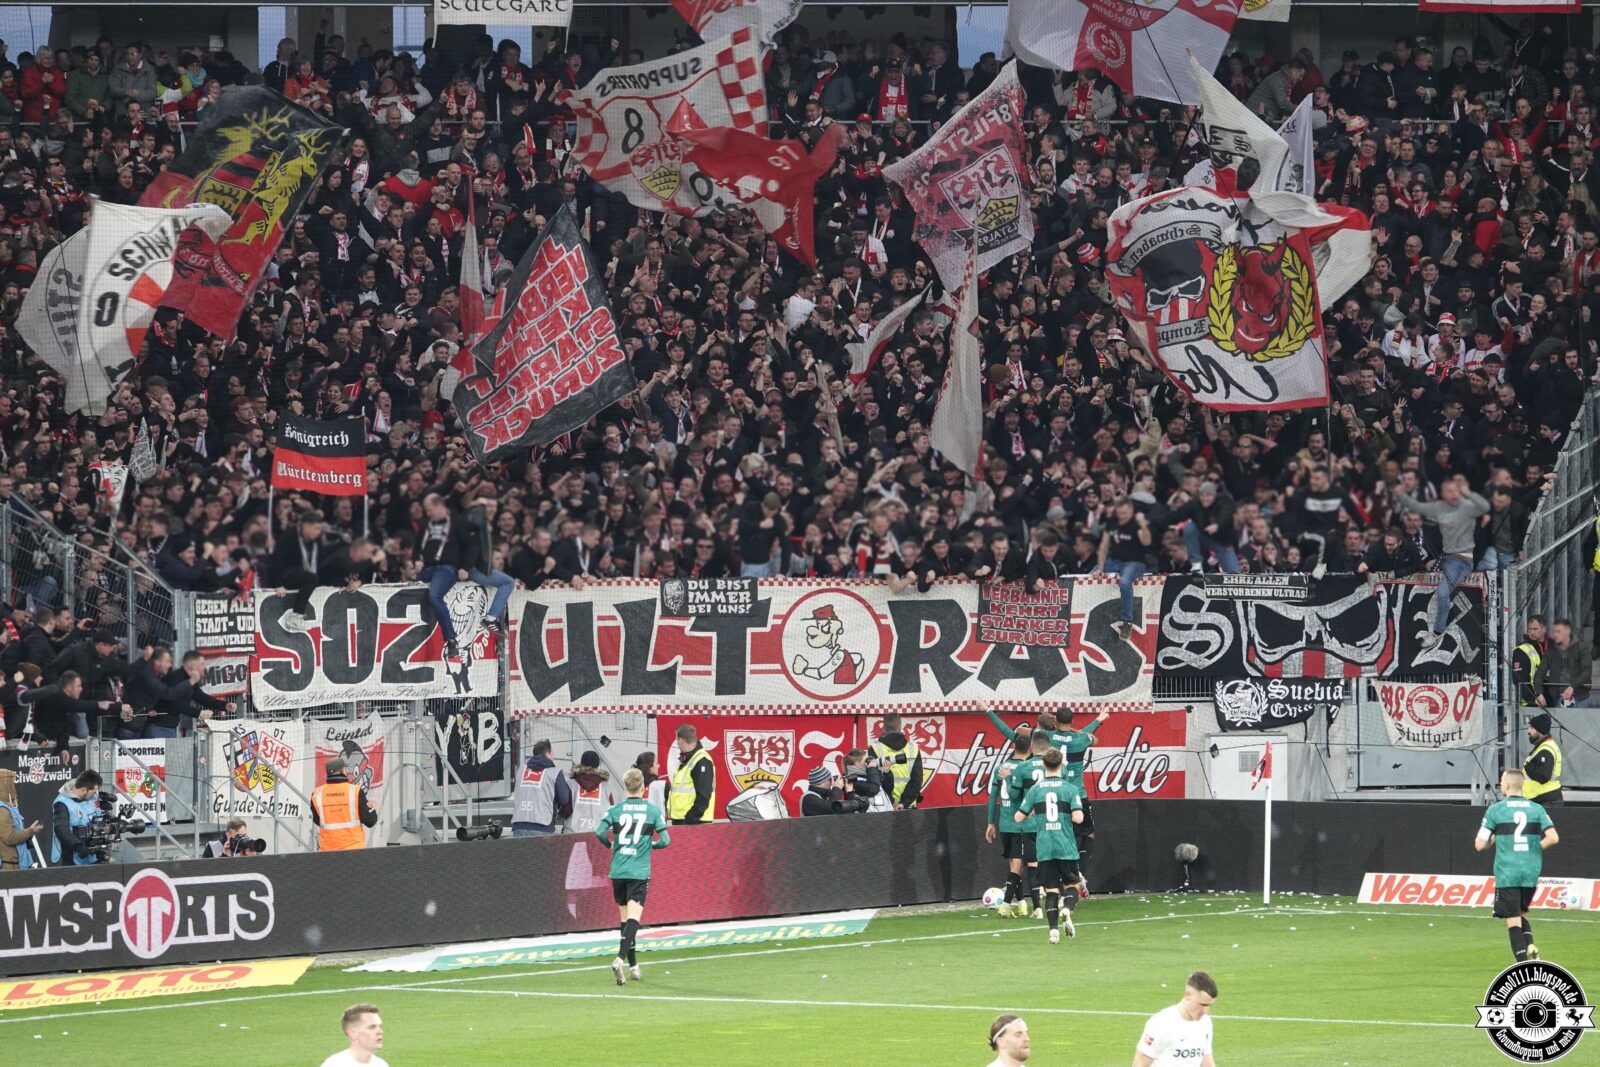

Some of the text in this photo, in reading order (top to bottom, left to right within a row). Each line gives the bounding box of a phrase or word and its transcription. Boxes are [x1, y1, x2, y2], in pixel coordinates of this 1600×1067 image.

[687, 580, 751, 590] DU BIST
[1223, 575, 1290, 585] EHRE ALLEN
[687, 591, 752, 603] IMMER
[1206, 587, 1306, 599] VERSTORBENEN ULTRAS
[195, 598, 228, 615] GEGEN
[687, 604, 752, 614] BEI UNS!
[990, 602, 1061, 617] KEHRT
[195, 616, 235, 634] STADT-
[1453, 682, 1481, 723] 07
[273, 728, 286, 740] 07
[1394, 722, 1464, 748] Stuttgart
[1098, 726, 1170, 796] die
[1045, 792, 1059, 822] 6
[618, 813, 647, 845] 27
[1513, 811, 1528, 843] 2
[3, 966, 253, 1000] LOTTO
